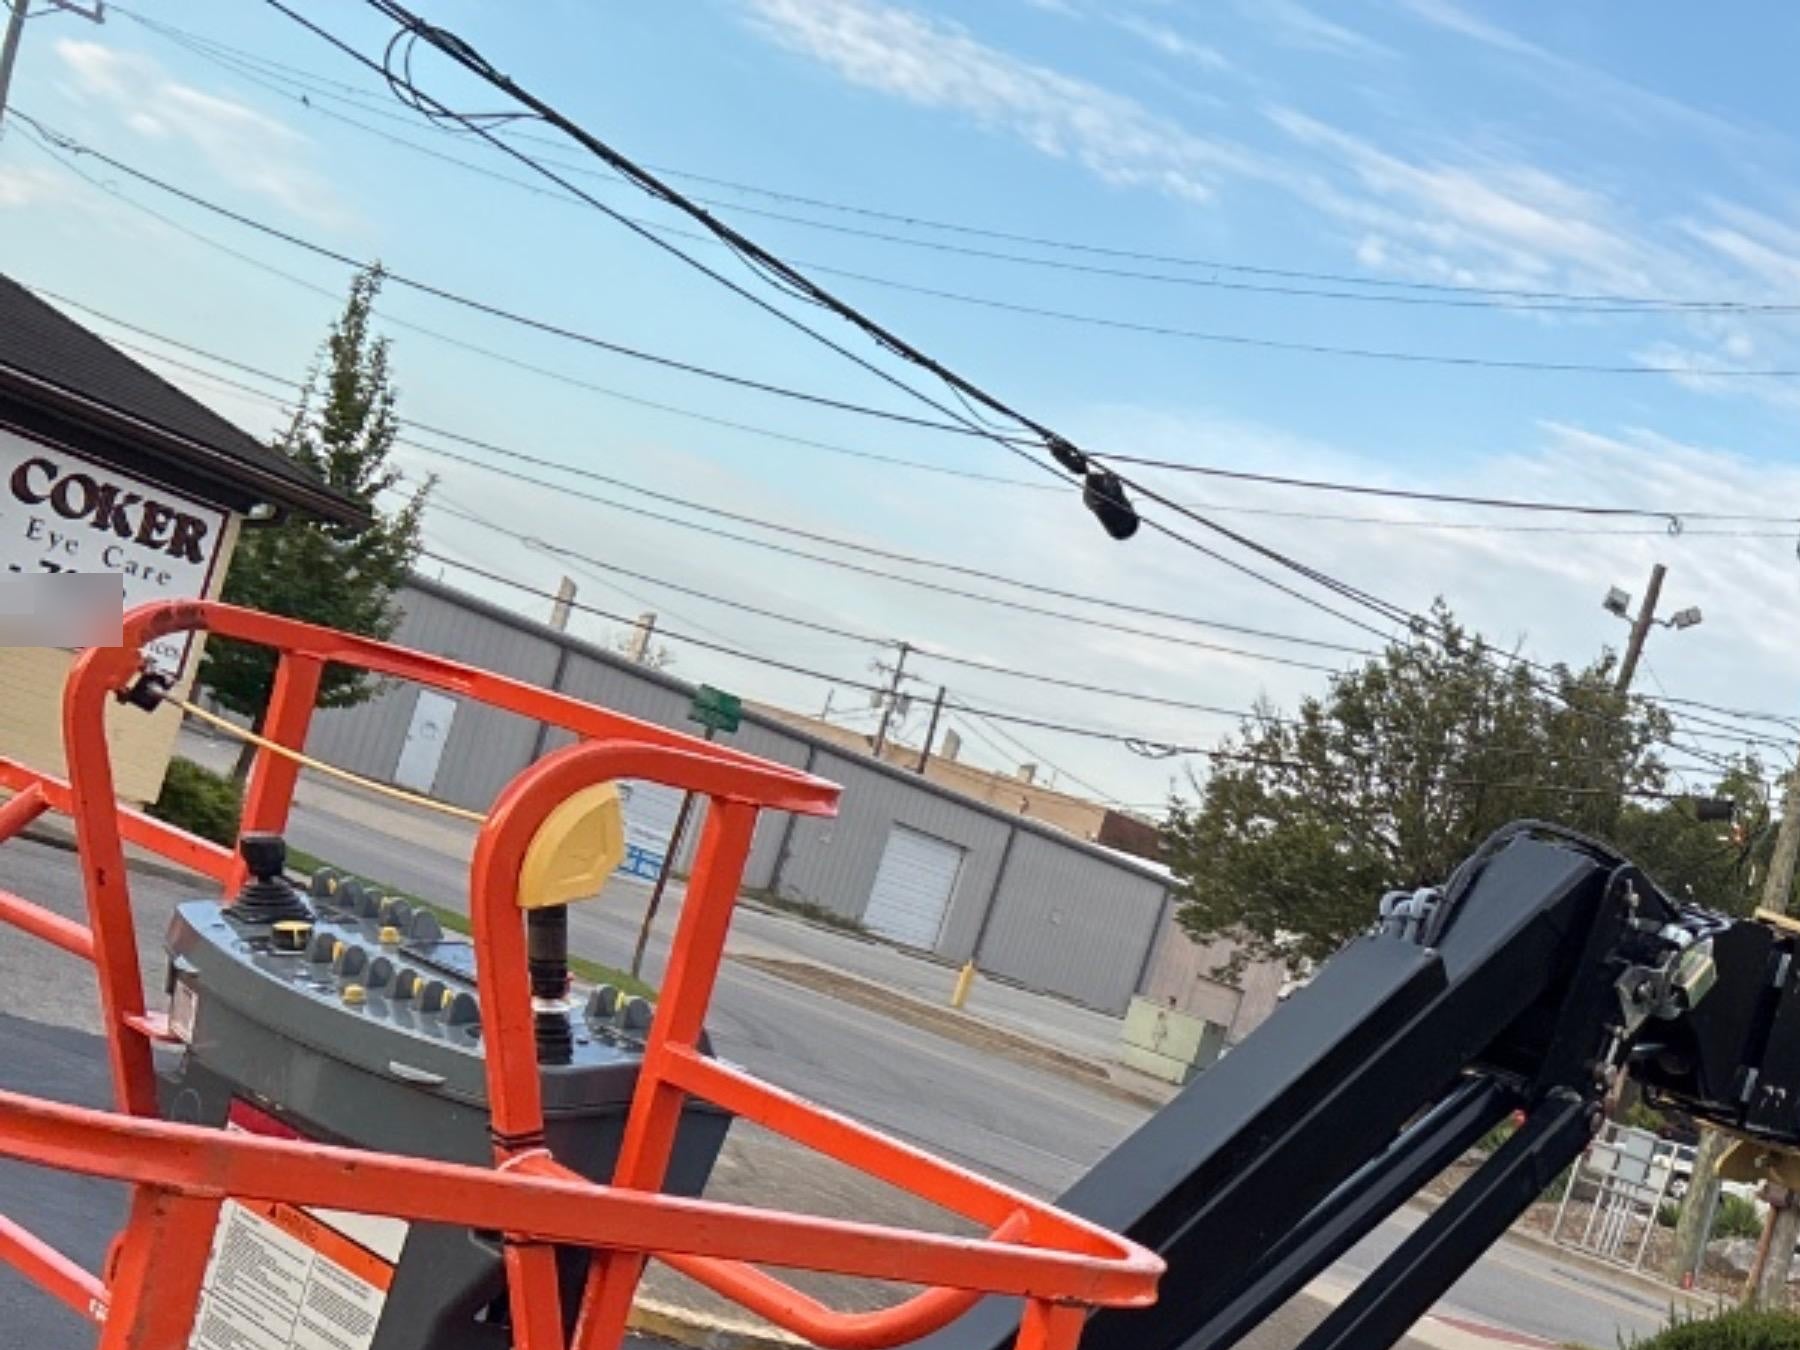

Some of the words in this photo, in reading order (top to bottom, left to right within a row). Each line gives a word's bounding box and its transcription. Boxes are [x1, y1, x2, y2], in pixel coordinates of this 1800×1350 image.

[9, 457, 208, 565] COKER
[25, 515, 80, 555] Eye
[102, 545, 172, 586] Care
